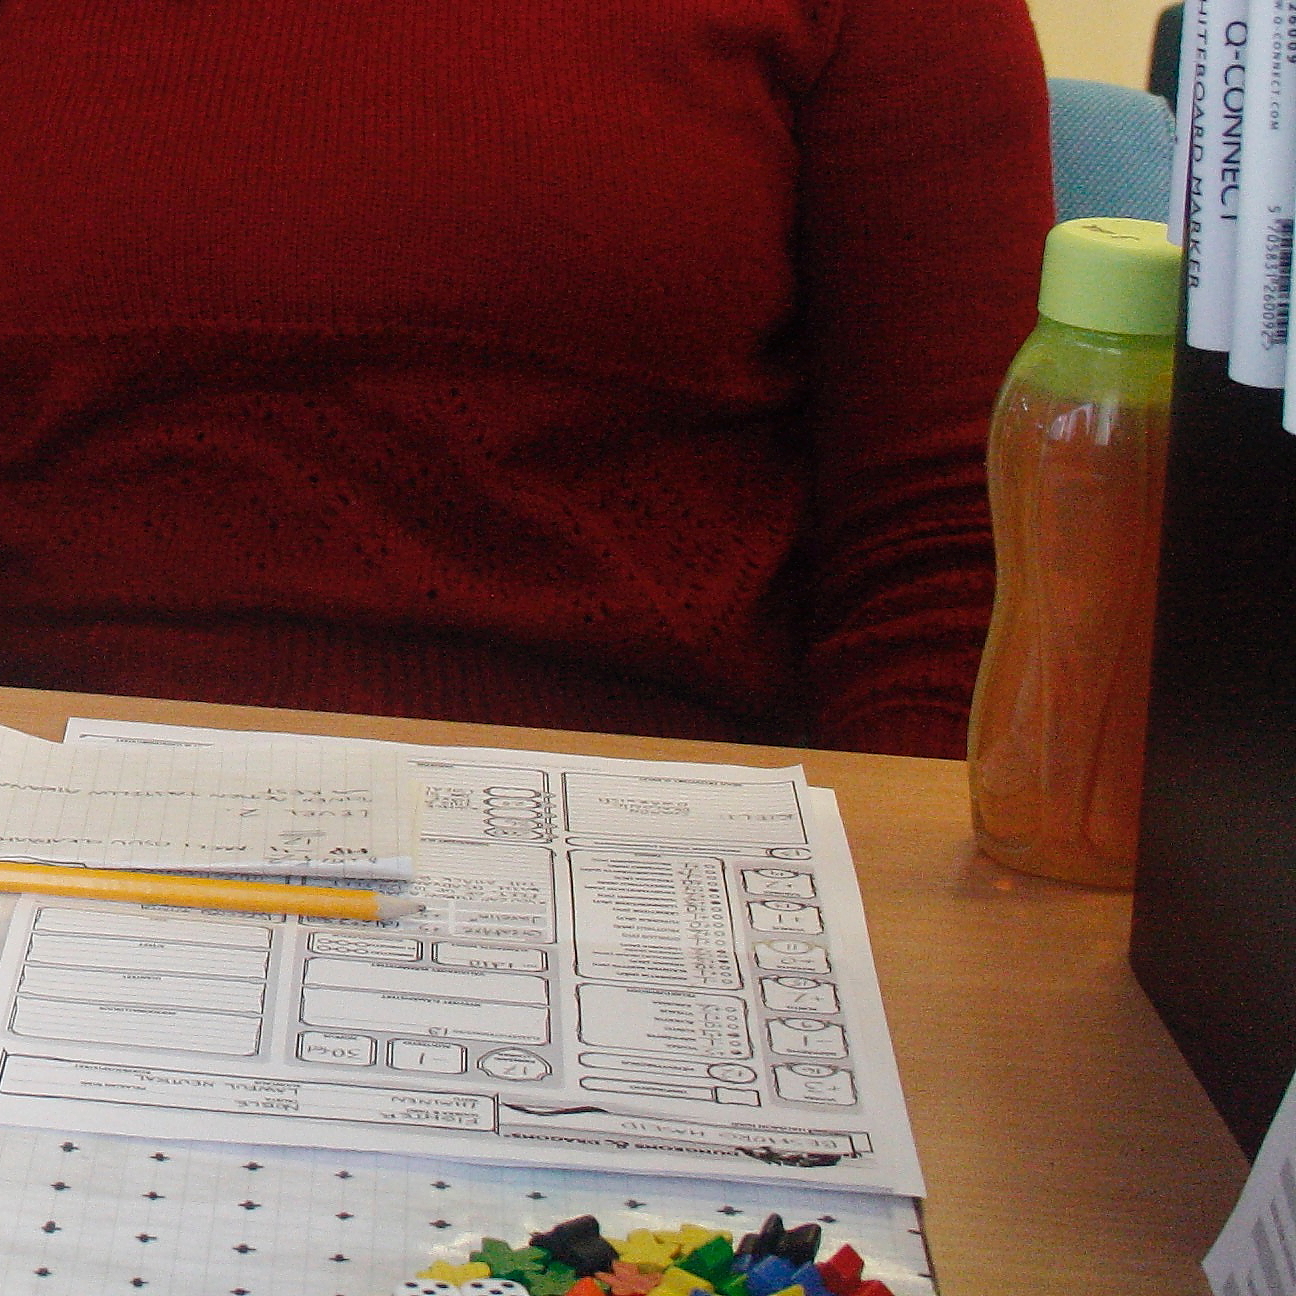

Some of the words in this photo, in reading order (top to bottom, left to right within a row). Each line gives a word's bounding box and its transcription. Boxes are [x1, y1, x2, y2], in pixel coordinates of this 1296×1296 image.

[1219, 21, 1249, 225] Q-CONNECT
[1188, 176, 1204, 289] MARKER
[133, 1073, 215, 1089] NEUTRAL
[224, 1082, 299, 1097] LAWFUL
